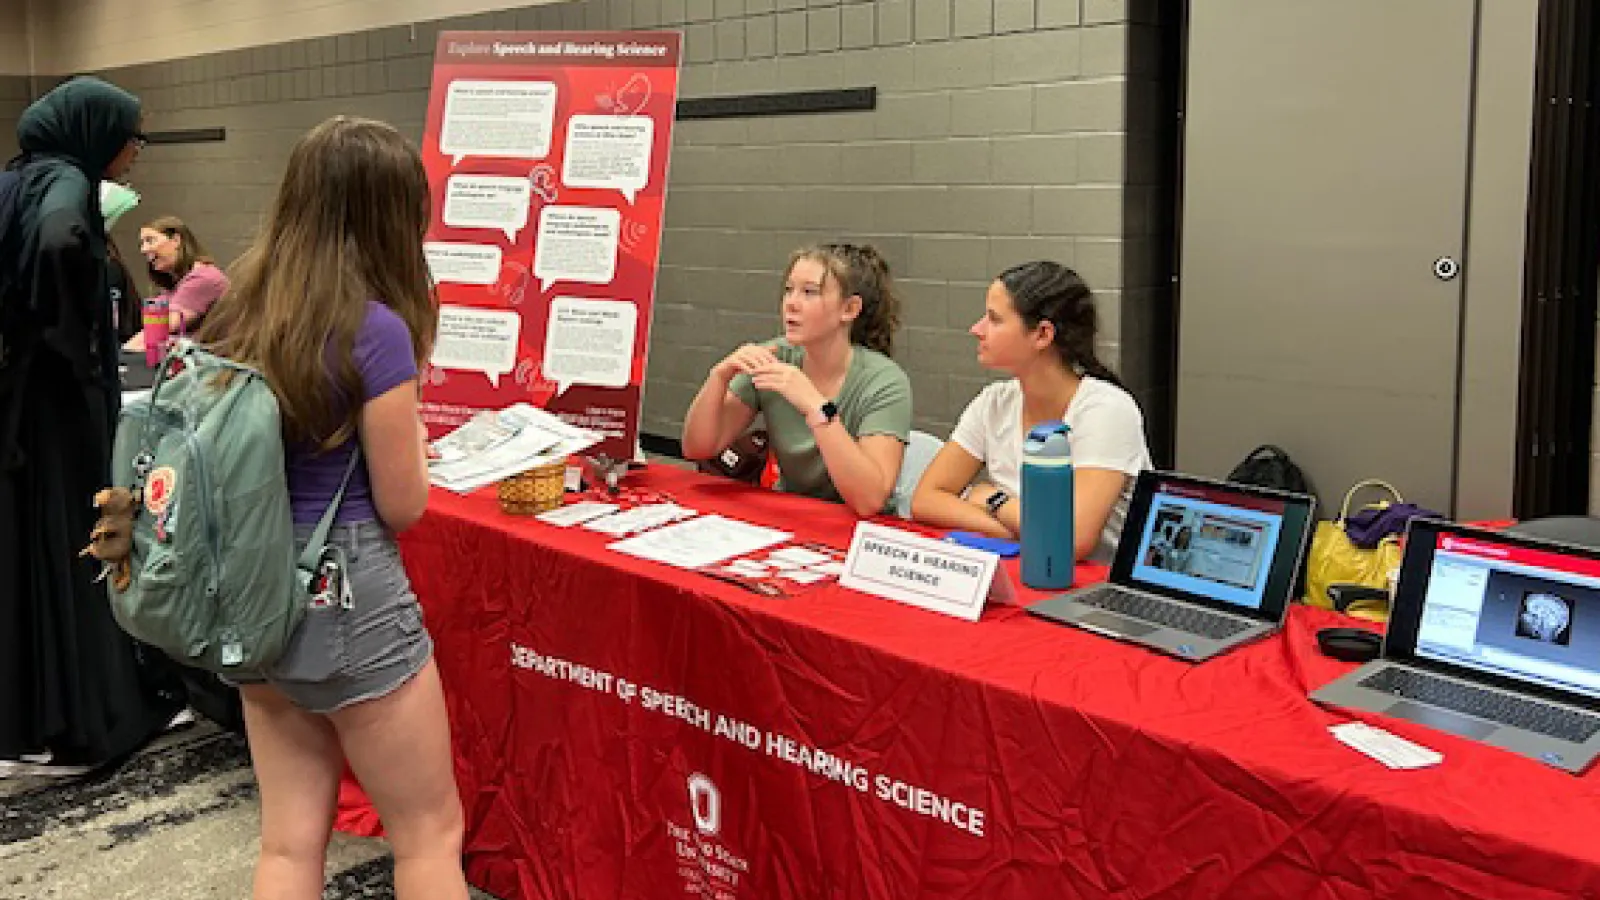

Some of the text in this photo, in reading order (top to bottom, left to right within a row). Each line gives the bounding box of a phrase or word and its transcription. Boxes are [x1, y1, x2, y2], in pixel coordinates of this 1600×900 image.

[492, 42, 536, 56] Speech
[538, 42, 561, 55] and
[563, 43, 614, 58] Hearing
[616, 43, 668, 57] Science
[863, 540, 979, 578] SPEECH & HEARING
[889, 565, 941, 587] SCIENCE
[616, 678, 637, 703] OF
[639, 686, 710, 730] SPEECH
[712, 715, 762, 749] AND
[765, 731, 869, 792] HEARING
[875, 774, 984, 837] SCIENCE
